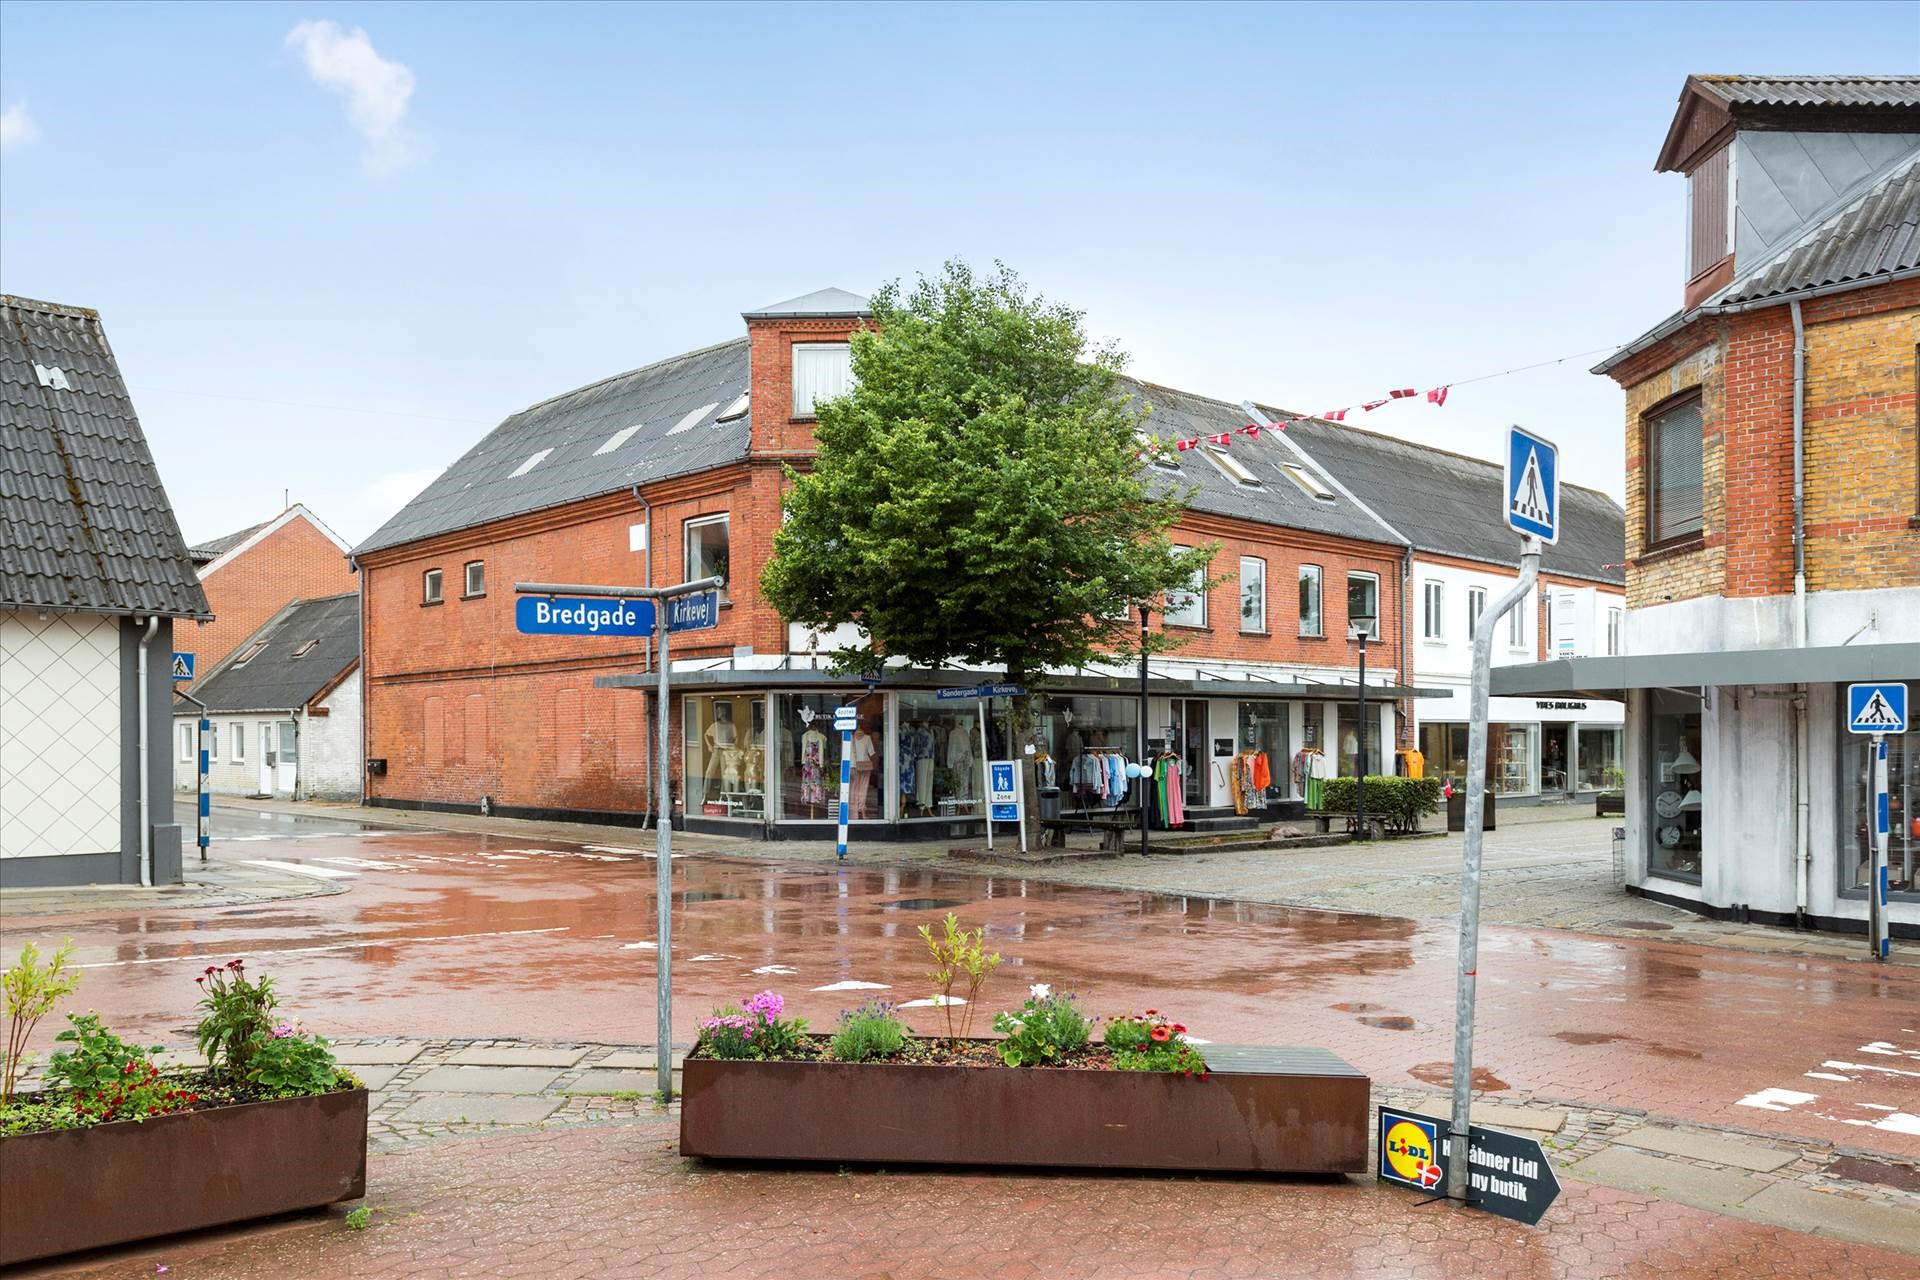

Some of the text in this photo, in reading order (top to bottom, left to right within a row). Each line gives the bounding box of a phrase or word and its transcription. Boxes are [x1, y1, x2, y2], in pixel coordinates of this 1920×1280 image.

[536, 602, 636, 631] Bredgade
[673, 597, 709, 625] Kirkevej
[1469, 1144, 1510, 1172] åbner
[1512, 1156, 1538, 1180] Lidl
[1471, 1173, 1488, 1192] ny
[1490, 1175, 1527, 1202] butik
